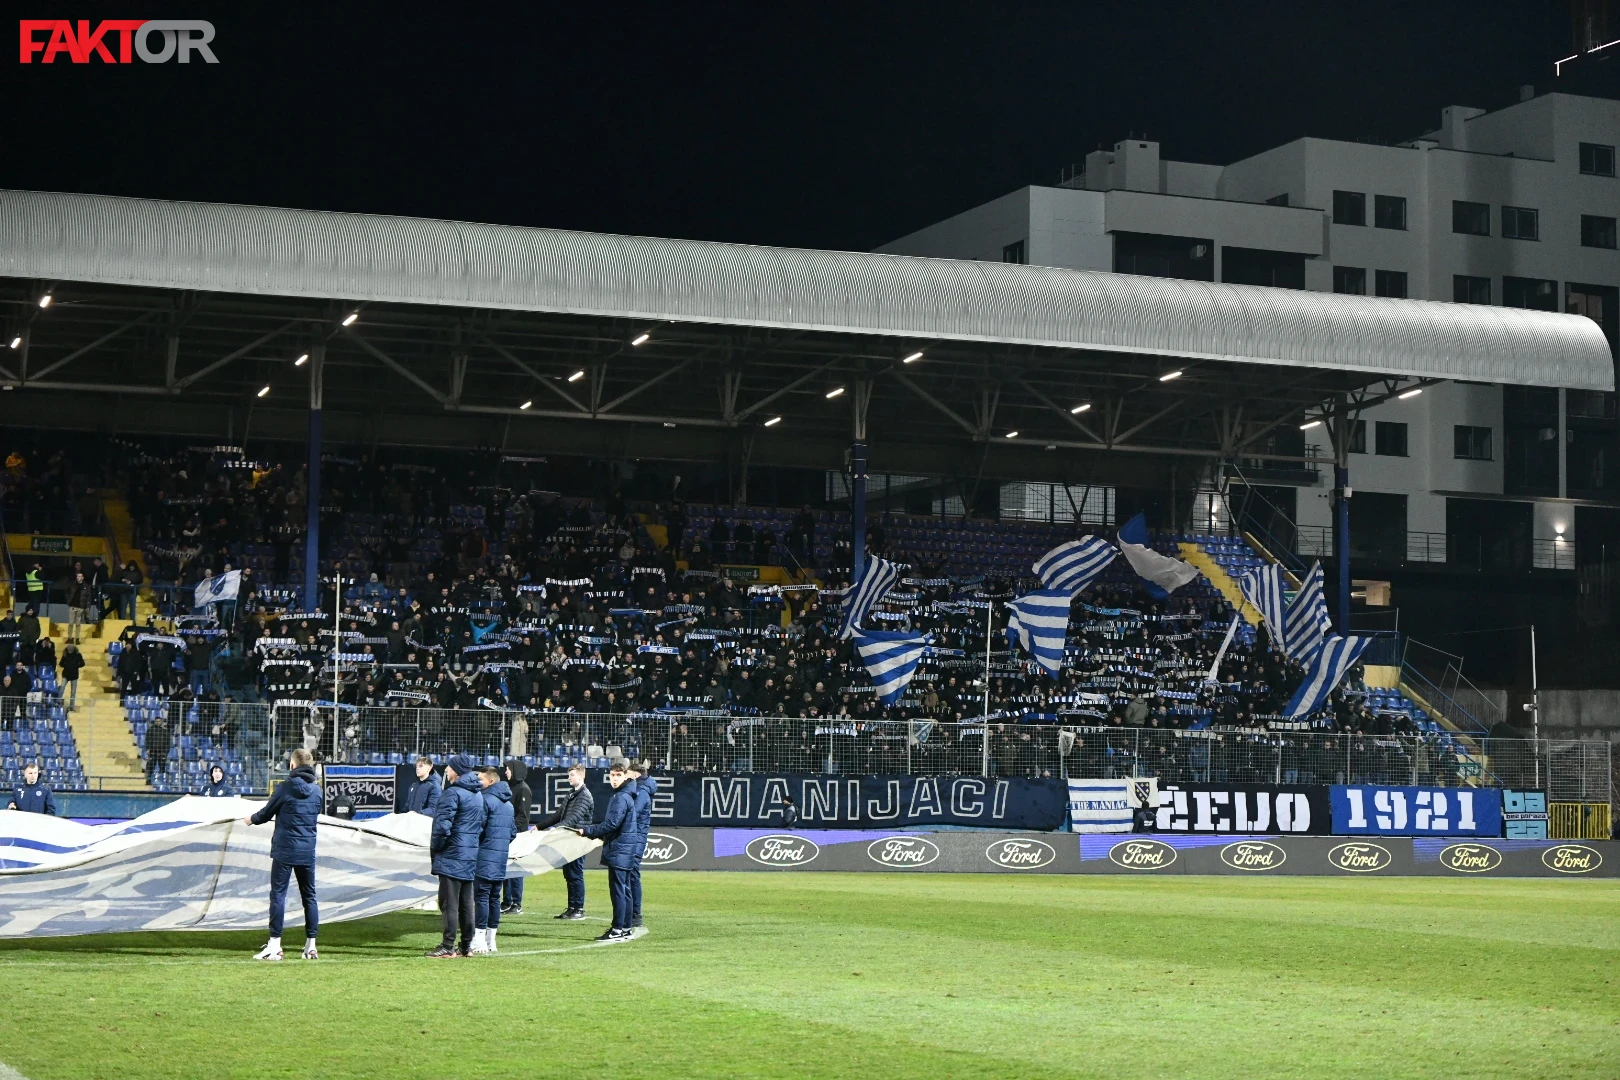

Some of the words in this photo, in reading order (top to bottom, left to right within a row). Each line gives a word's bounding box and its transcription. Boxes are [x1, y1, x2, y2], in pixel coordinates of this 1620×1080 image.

[700, 776, 1009, 821] MANIJACI
[1071, 801, 1090, 810] THE
[1346, 789, 1477, 831] 1921
[760, 839, 805, 862] Ford
[881, 840, 926, 863] Ford
[1000, 842, 1042, 864] Ford
[1123, 843, 1164, 865] Ford
[1233, 844, 1273, 866] Ford
[1340, 846, 1379, 867] Ford
[1451, 848, 1489, 868] Ford
[1553, 849, 1591, 869] Ford
